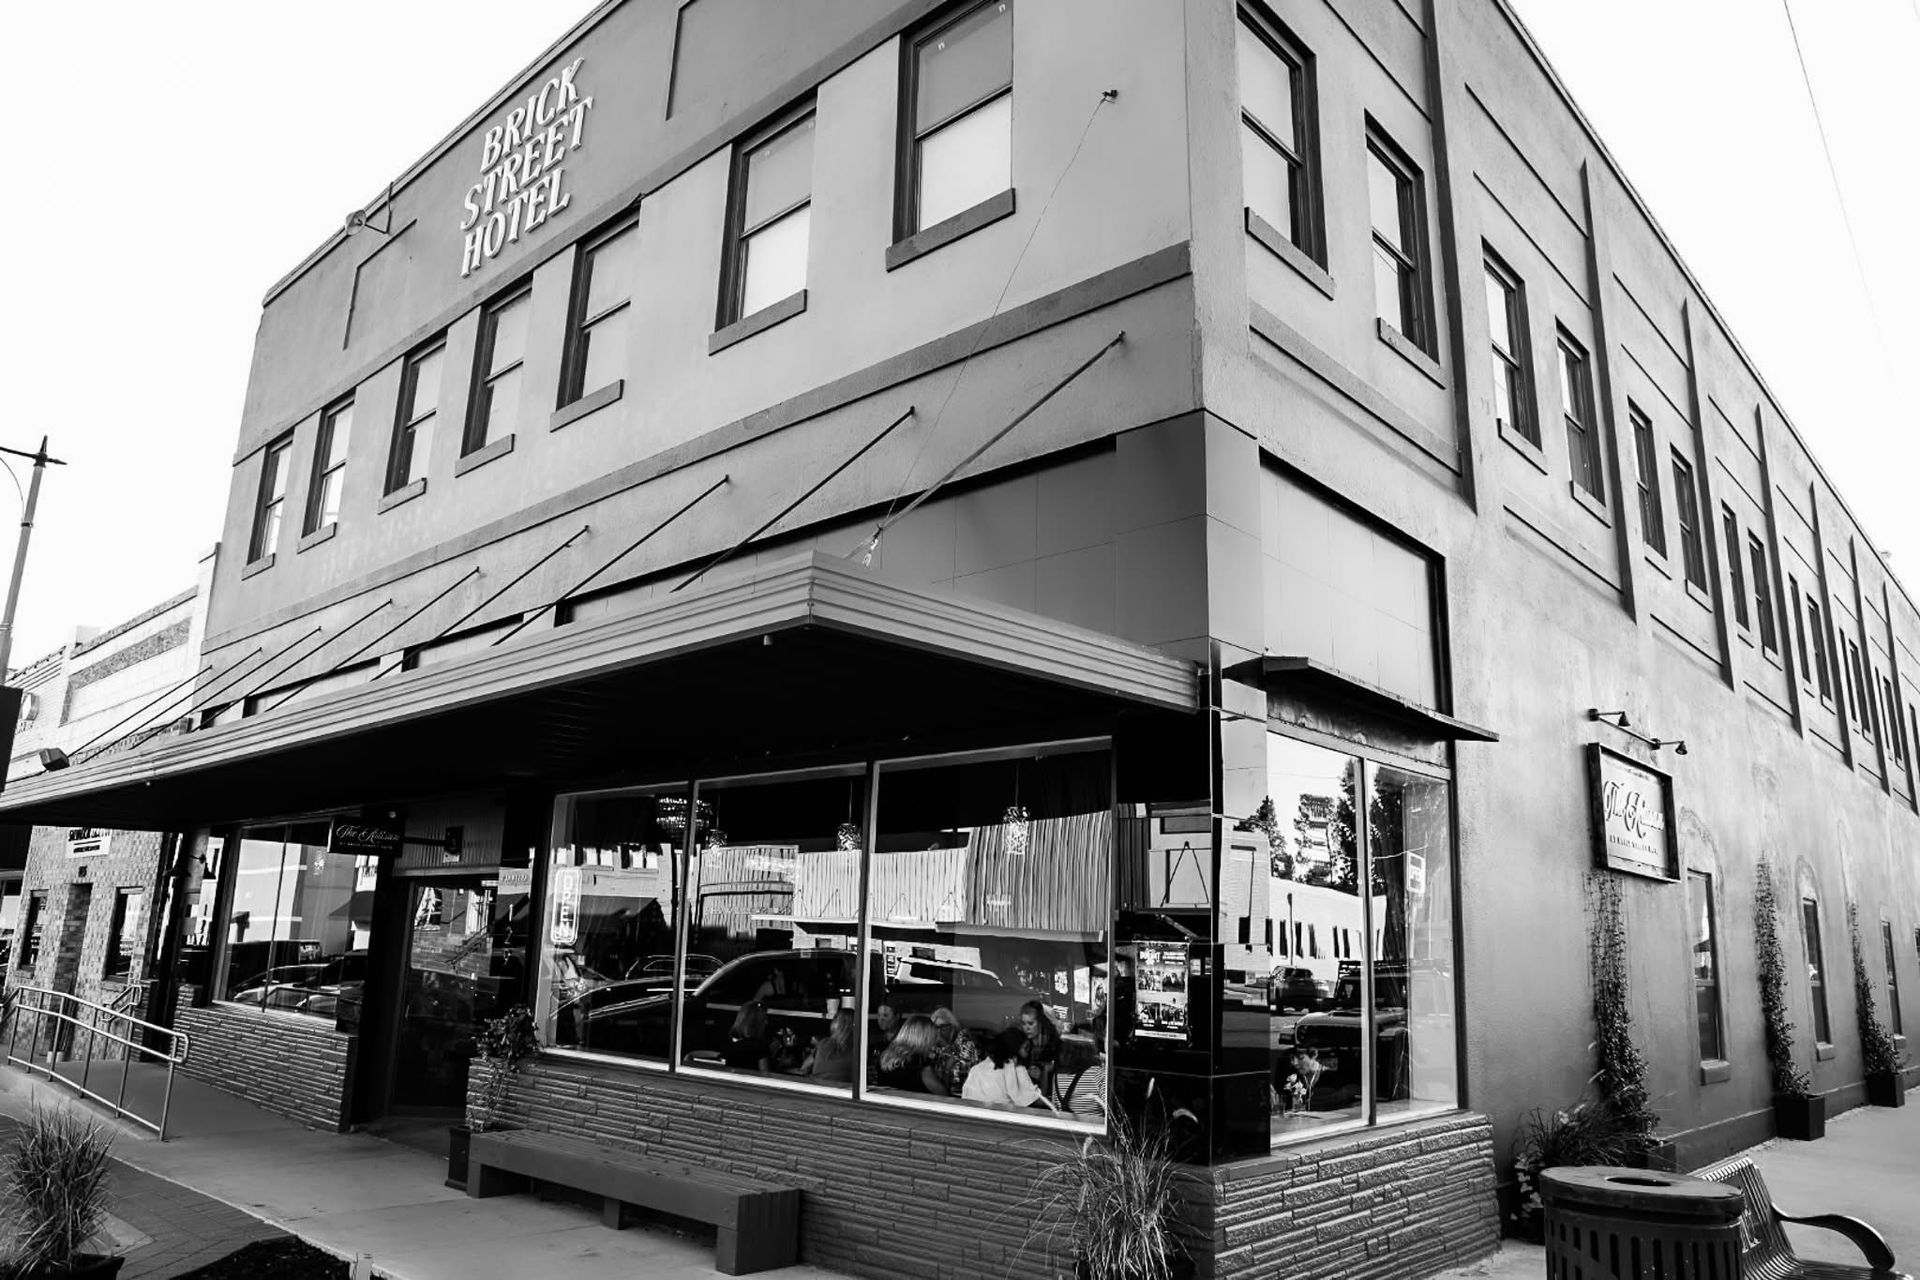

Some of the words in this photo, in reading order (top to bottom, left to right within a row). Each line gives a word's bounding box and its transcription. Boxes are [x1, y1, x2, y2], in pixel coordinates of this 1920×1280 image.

[460, 96, 594, 232] STREET
[480, 57, 584, 175] BRICK
[460, 167, 571, 278] HOTEL
[335, 824, 361, 839] The
[558, 875, 573, 938] OPEN
